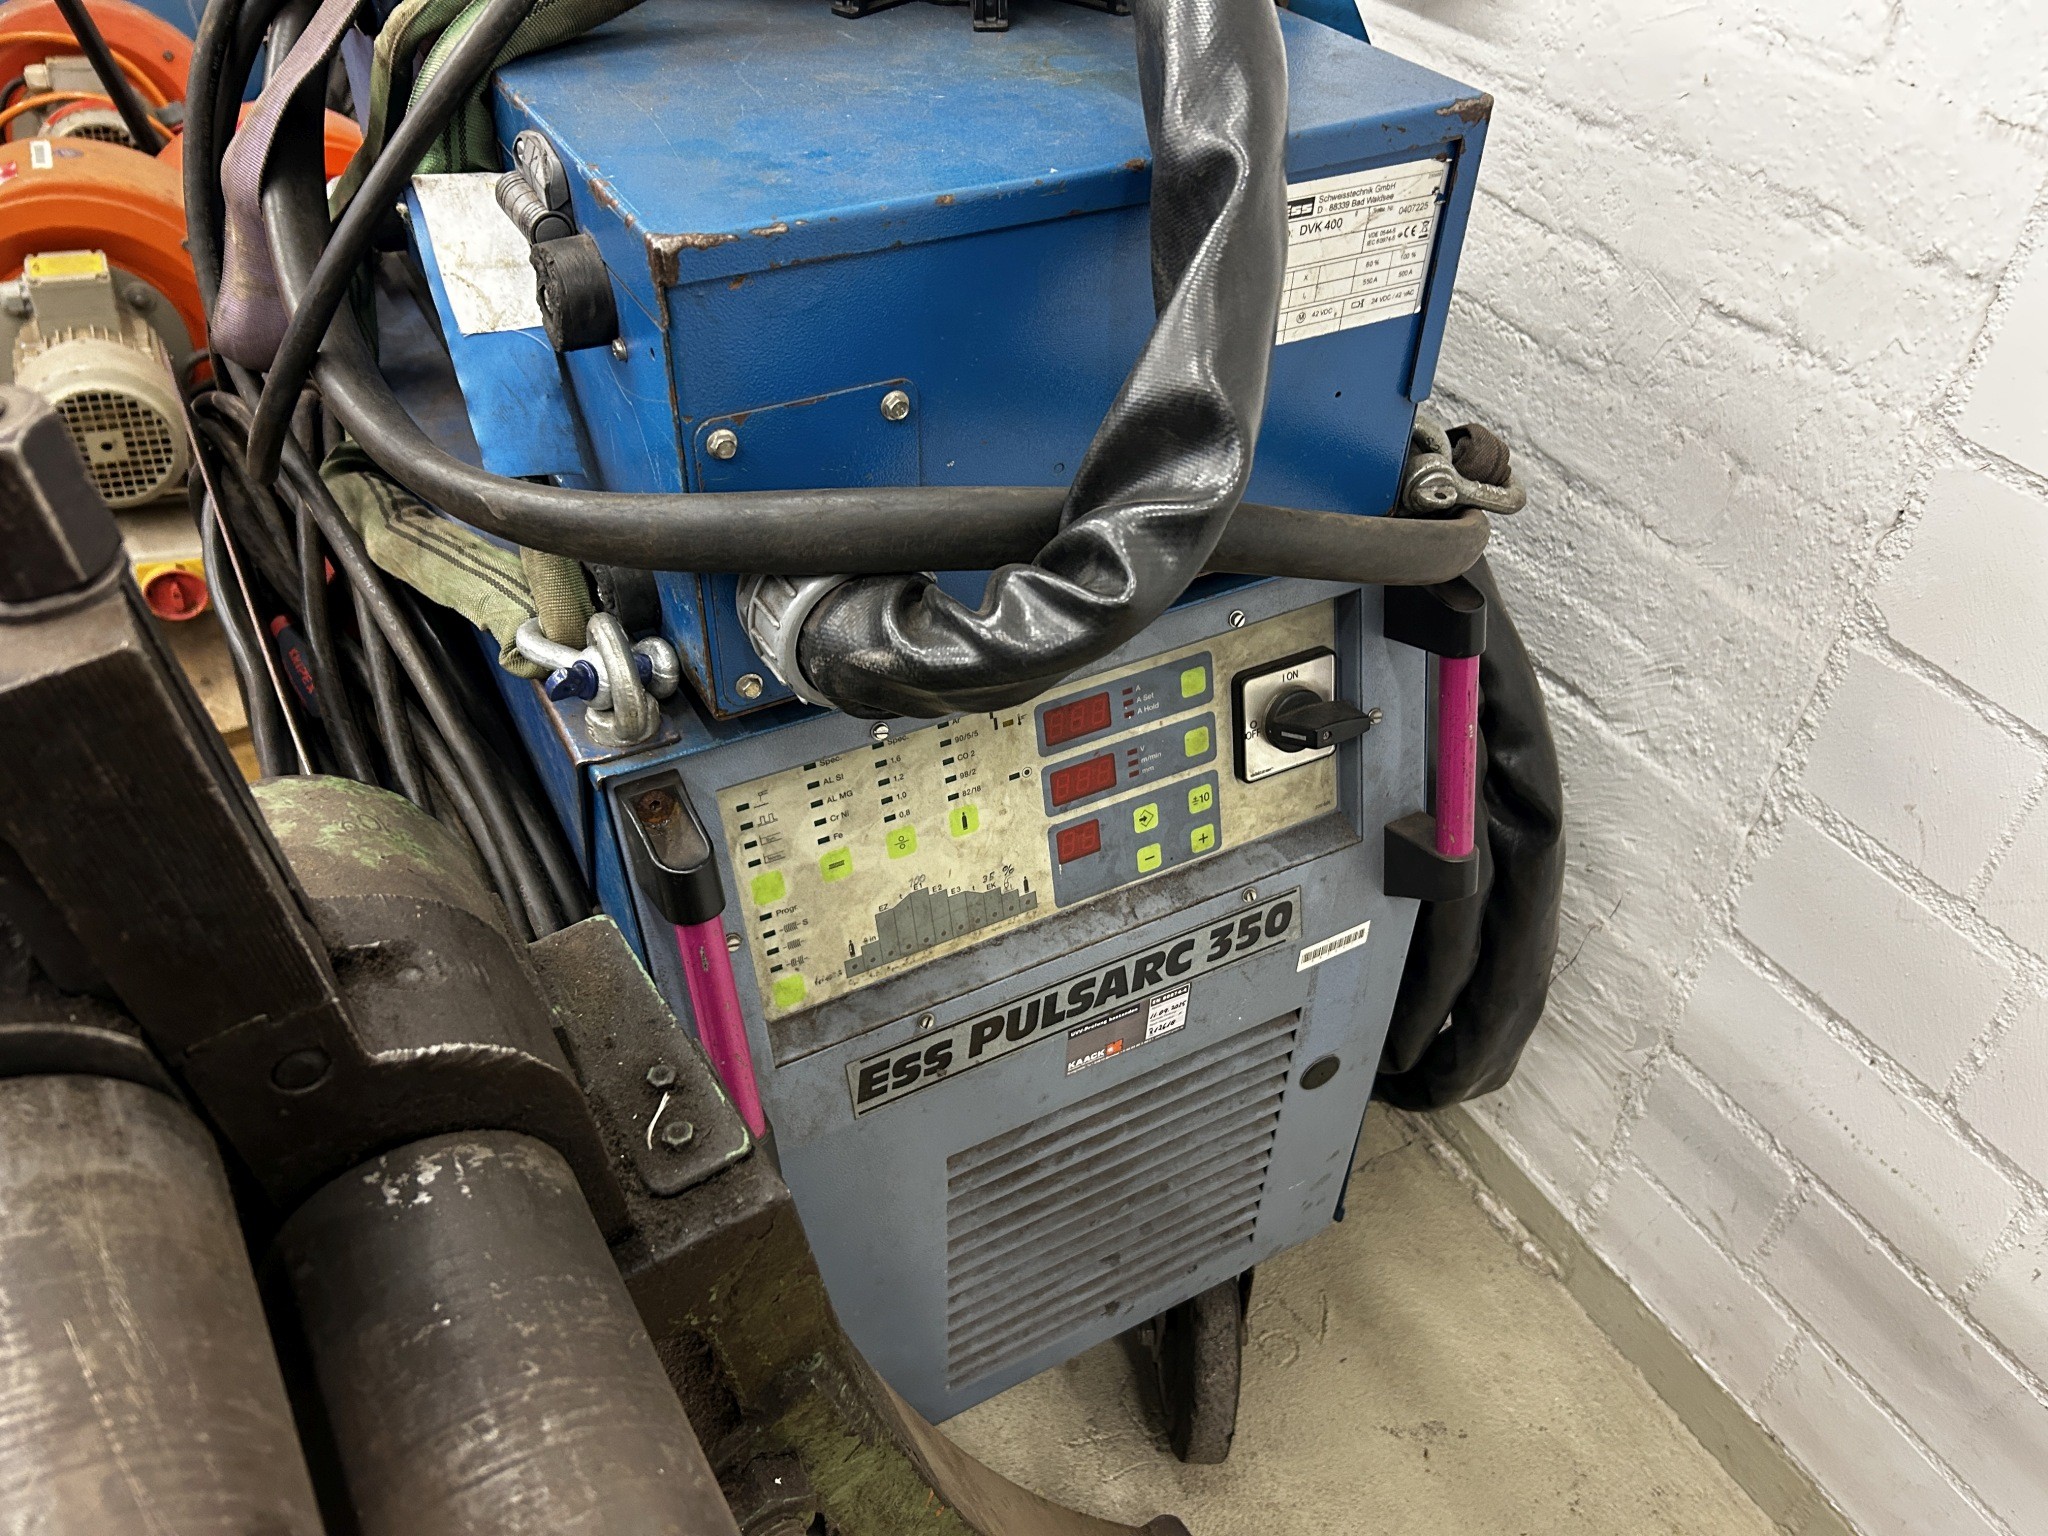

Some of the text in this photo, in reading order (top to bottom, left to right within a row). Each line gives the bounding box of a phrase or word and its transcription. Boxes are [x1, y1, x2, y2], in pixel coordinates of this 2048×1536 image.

[1318, 182, 1396, 204] Schweisstechnik GmbH
[1329, 202, 1350, 212] 88339
[1352, 198, 1365, 208] Bad
[1367, 193, 1394, 205] Waldsee
[1300, 221, 1322, 236] DVK
[1324, 218, 1343, 230] 400
[1286, 670, 1299, 681] ON
[1143, 692, 1154, 701] Set
[1144, 702, 1160, 712] Hold
[954, 731, 979, 743] 90/5/5
[1246, 728, 1261, 740] OFF
[887, 736, 909, 746] Spec.
[819, 756, 842, 767] Spec.
[890, 755, 901, 764] 1,6
[957, 752, 969, 761] CO
[1141, 752, 1162, 763] m/min
[893, 774, 904, 782] 1,2
[960, 768, 977, 780] 98/2
[839, 790, 853, 799] MG
[896, 792, 907, 800] 1,0
[962, 786, 982, 797] 82/18
[830, 814, 839, 822] Cr
[899, 810, 911, 819] 0,8
[833, 832, 844, 840] Fe
[932, 884, 942, 892] E2
[951, 886, 961, 895] E3
[986, 881, 996, 891] EK
[858, 1039, 953, 1105] ESS
[968, 938, 1195, 1060] PULSARC
[1206, 900, 1294, 964] 350
[1108, 1007, 1138, 1022] bestanden
[1068, 1049, 1105, 1069] KAACK
